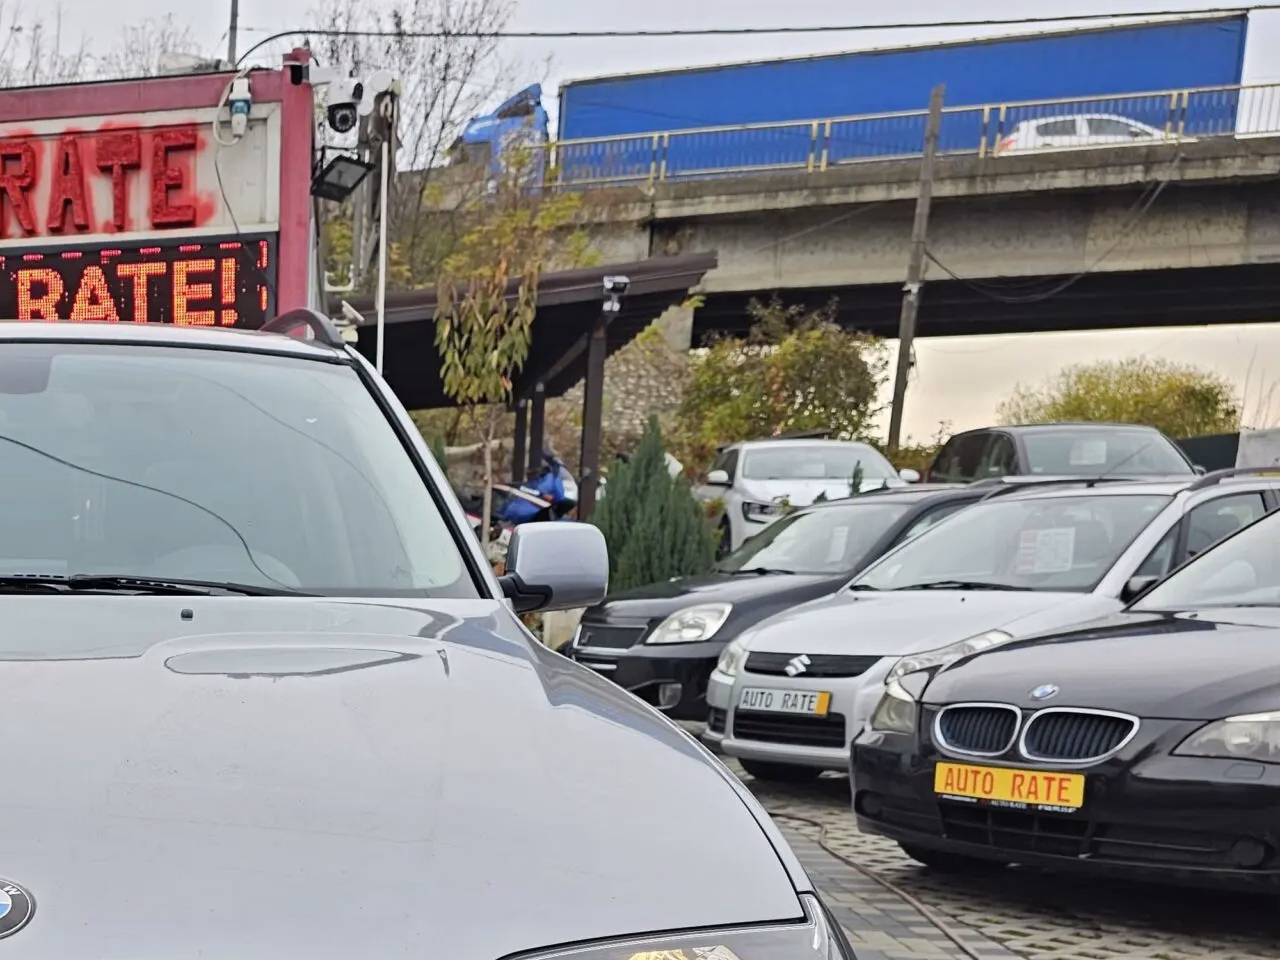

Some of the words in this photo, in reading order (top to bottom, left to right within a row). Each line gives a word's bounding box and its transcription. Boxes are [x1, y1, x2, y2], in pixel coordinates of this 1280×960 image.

[17, 257, 238, 327] RATE!
[742, 690, 773, 708] AUTO
[781, 693, 817, 712] RATE
[944, 767, 995, 796] AUTO
[1011, 773, 1072, 803] RATE
